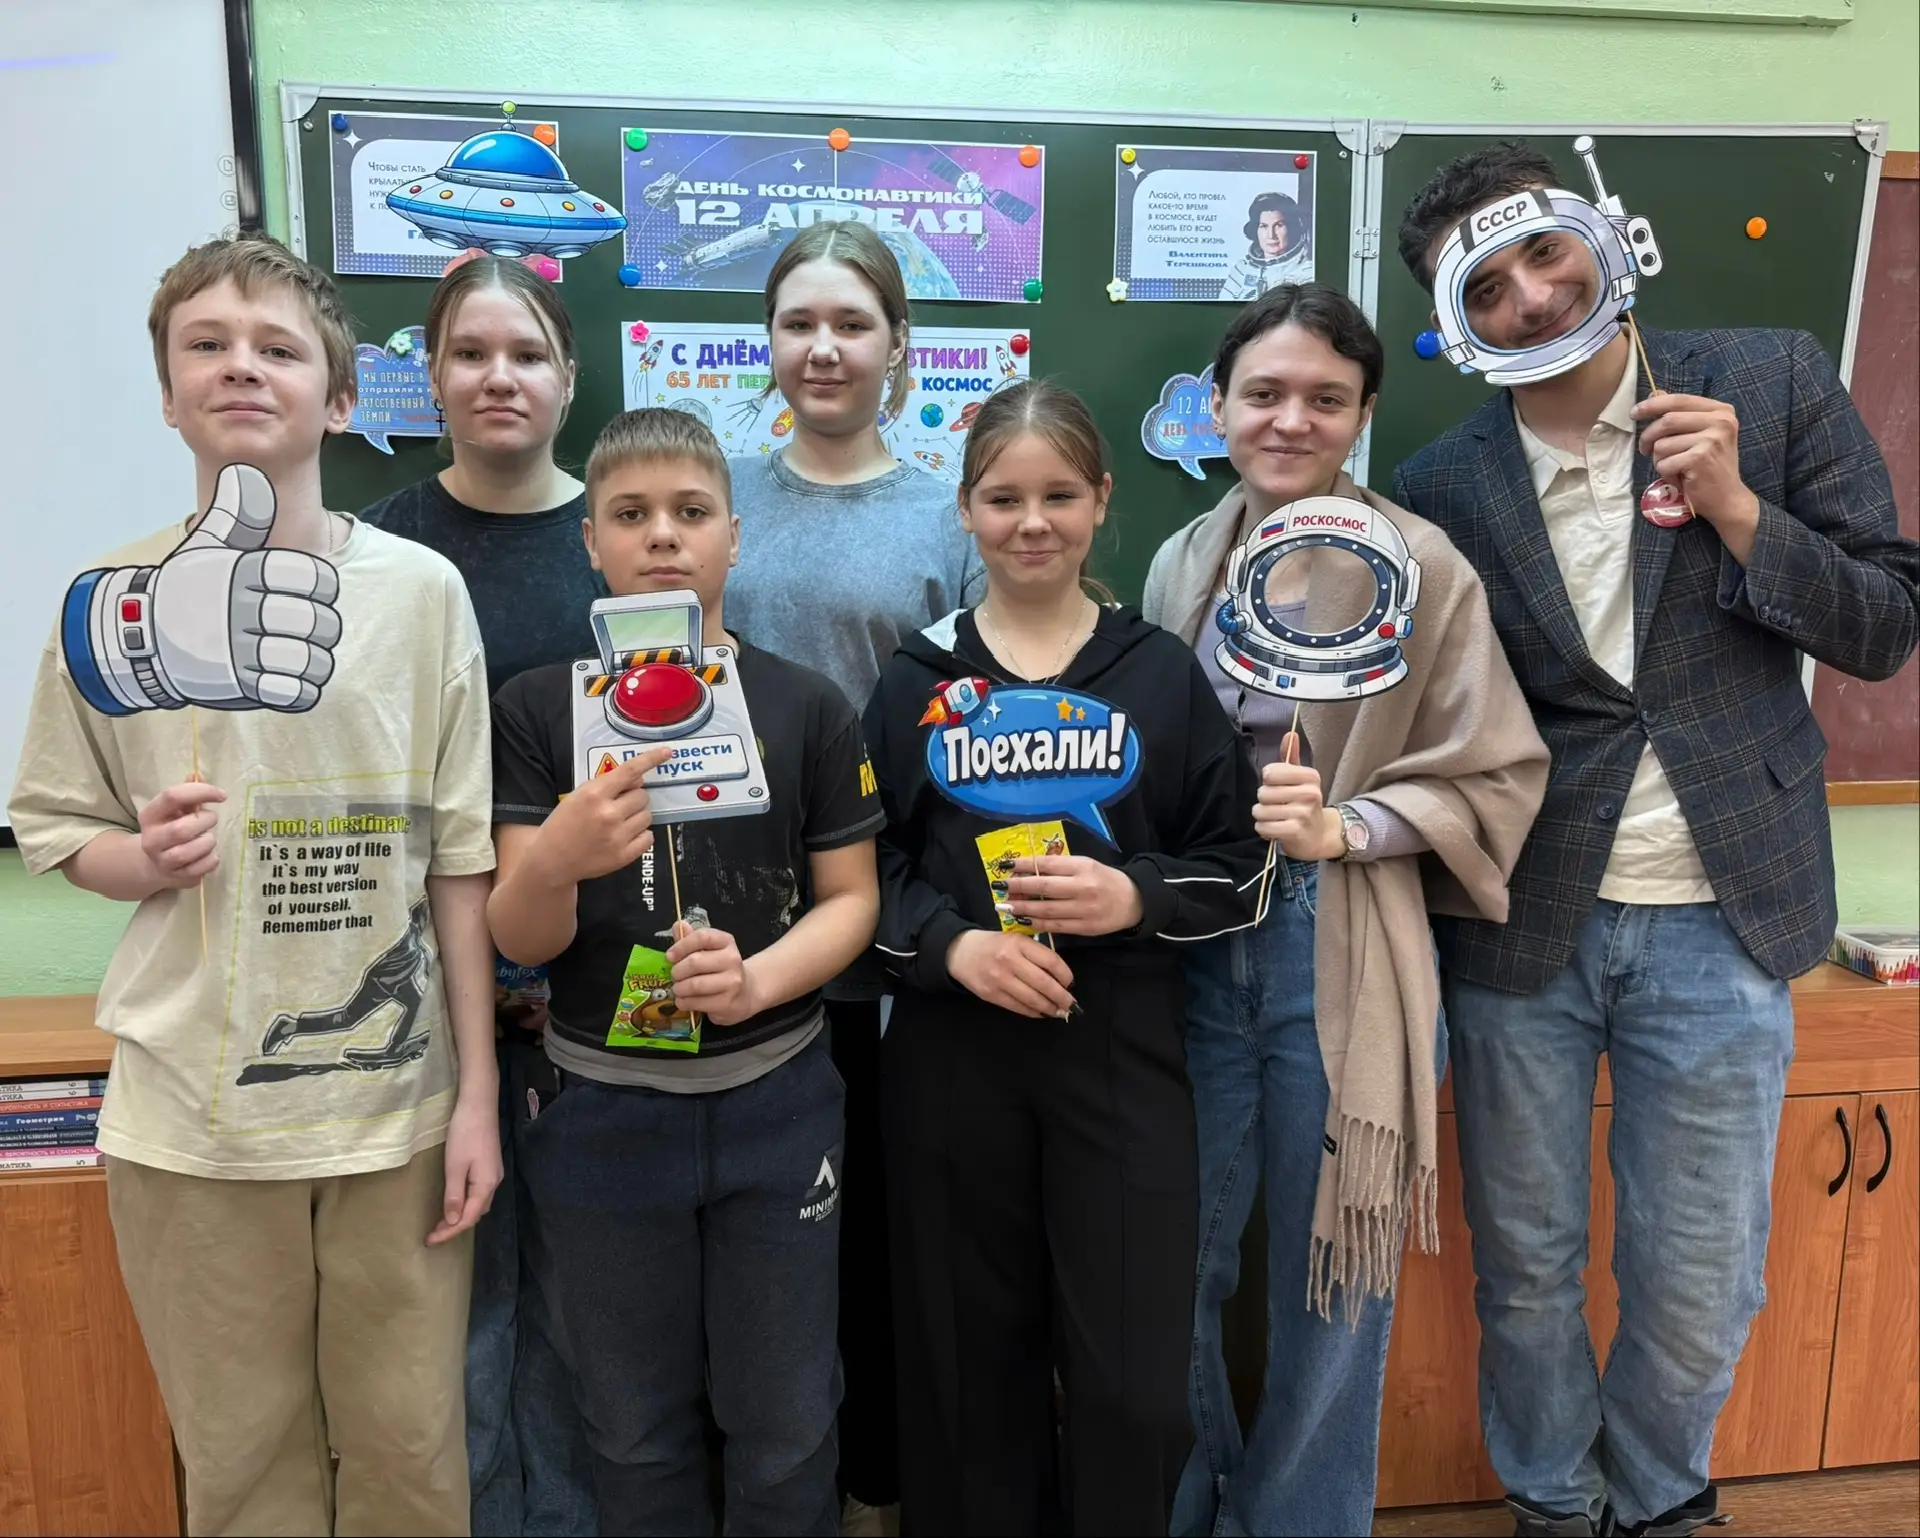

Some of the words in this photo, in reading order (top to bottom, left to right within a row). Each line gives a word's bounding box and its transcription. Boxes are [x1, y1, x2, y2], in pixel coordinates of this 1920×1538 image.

[675, 181, 749, 195] ДЕНЬ
[758, 184, 982, 205] КОСМОНАВТИКИ
[1199, 193, 1226, 201] ПРОВЕЛ
[675, 199, 740, 225] 12
[761, 203, 982, 235] АПРЕЛЯ
[1477, 200, 1527, 232] СССР
[672, 343, 687, 366] С
[696, 339, 770, 369] ДНЁМ
[907, 347, 988, 370] ВТИКИ!
[666, 371, 690, 388] 65
[697, 374, 731, 388] ЛЕТ
[922, 377, 993, 392] КОСМОС
[358, 387, 413, 395] отправили
[1178, 396, 1191, 414] 12
[1293, 515, 1367, 532] РОСКОСМОС
[622, 744, 732, 762] Пзвести
[942, 713, 1126, 782] Поехали!
[657, 761, 703, 777] пуск
[249, 819, 267, 838] is
[272, 818, 307, 837] not
[310, 819, 323, 836] a
[297, 847, 306, 860] a
[311, 846, 343, 860] way
[345, 843, 361, 857] of
[365, 842, 391, 857] life
[305, 865, 327, 878] my
[334, 863, 359, 876] way
[262, 882, 286, 896] the
[290, 882, 323, 894] best
[327, 878, 377, 893] version
[268, 902, 282, 915] of
[289, 898, 351, 915] yourself.
[262, 918, 342, 934] Remember
[345, 915, 373, 928] that
